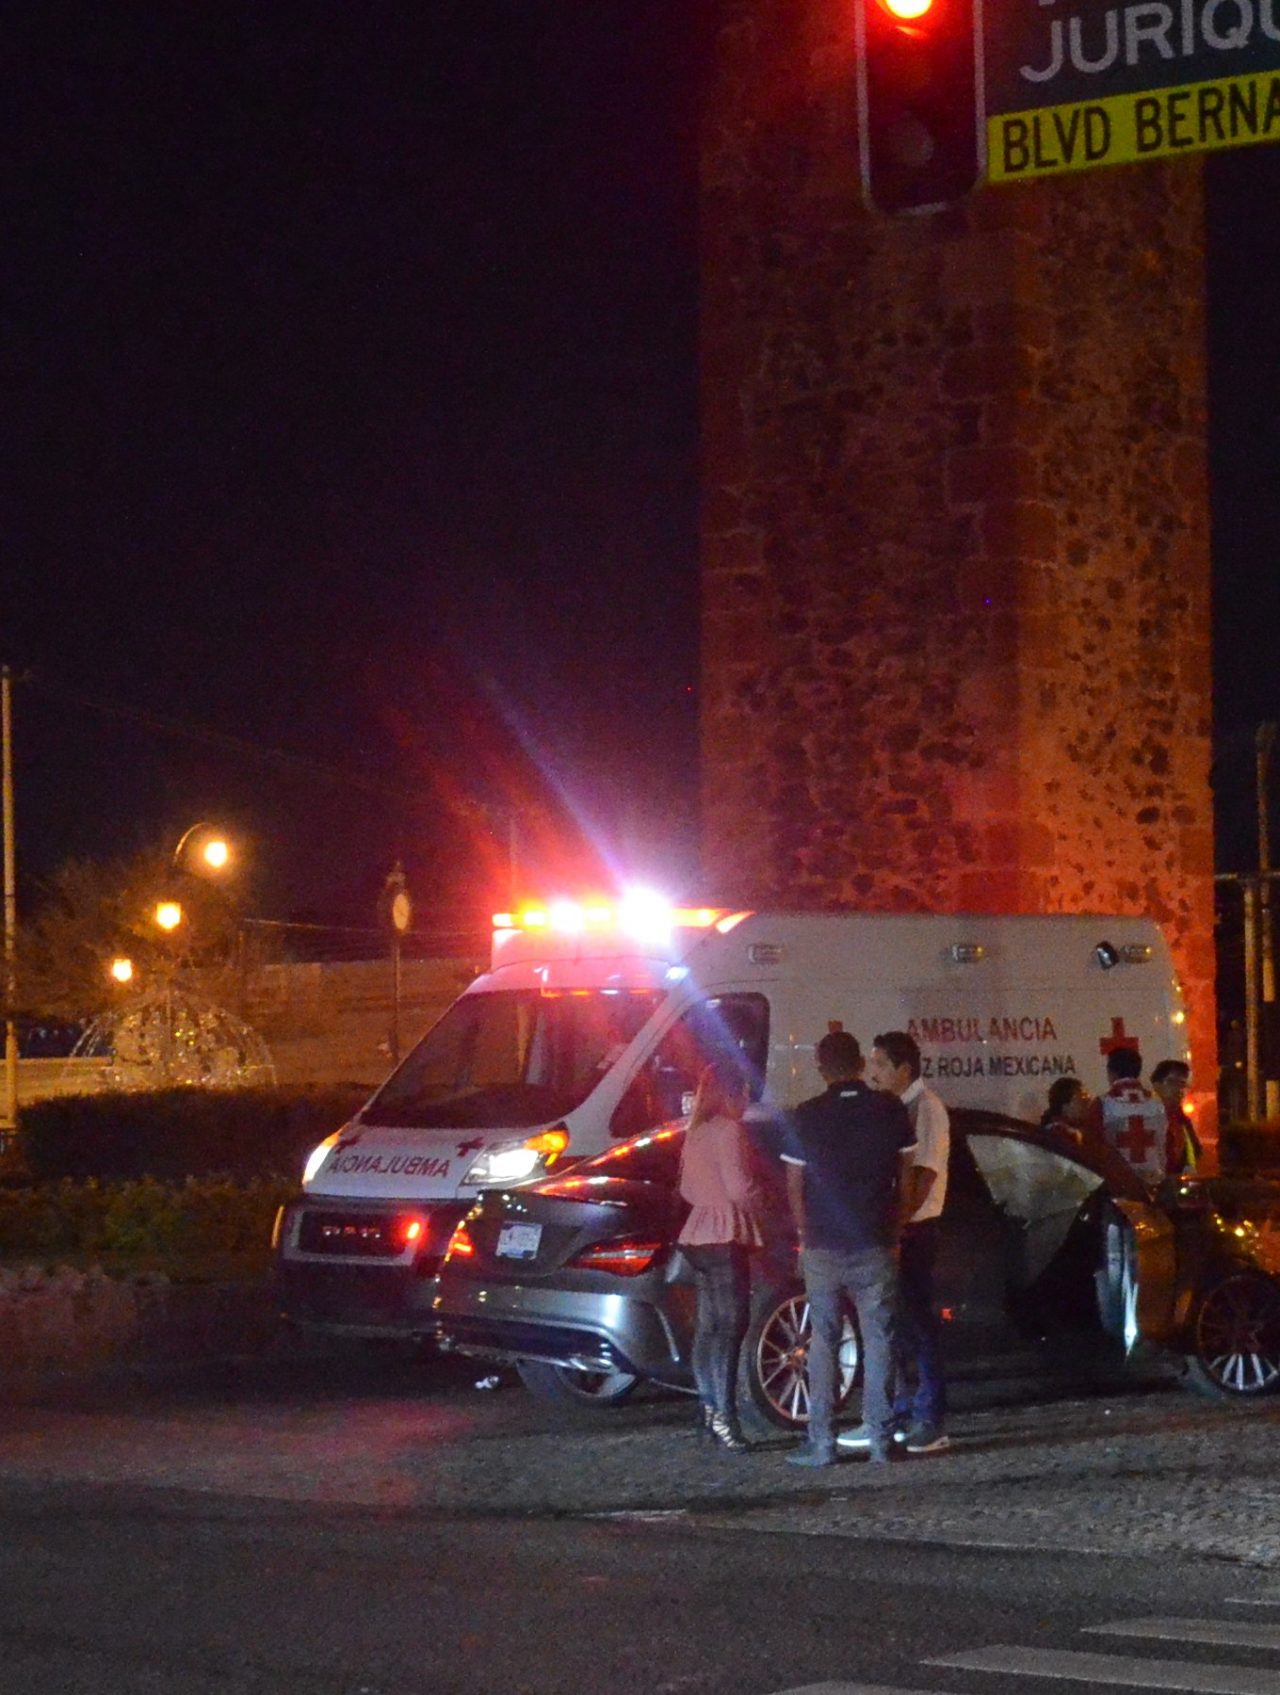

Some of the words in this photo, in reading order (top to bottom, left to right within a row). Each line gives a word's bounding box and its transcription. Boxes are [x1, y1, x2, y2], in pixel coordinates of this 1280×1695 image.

[1002, 105, 1111, 173] BLVD
[907, 1016, 1058, 1042] AMBULANCIA
[938, 1056, 985, 1078] ROJA
[989, 1055, 1077, 1076] MEXICANA
